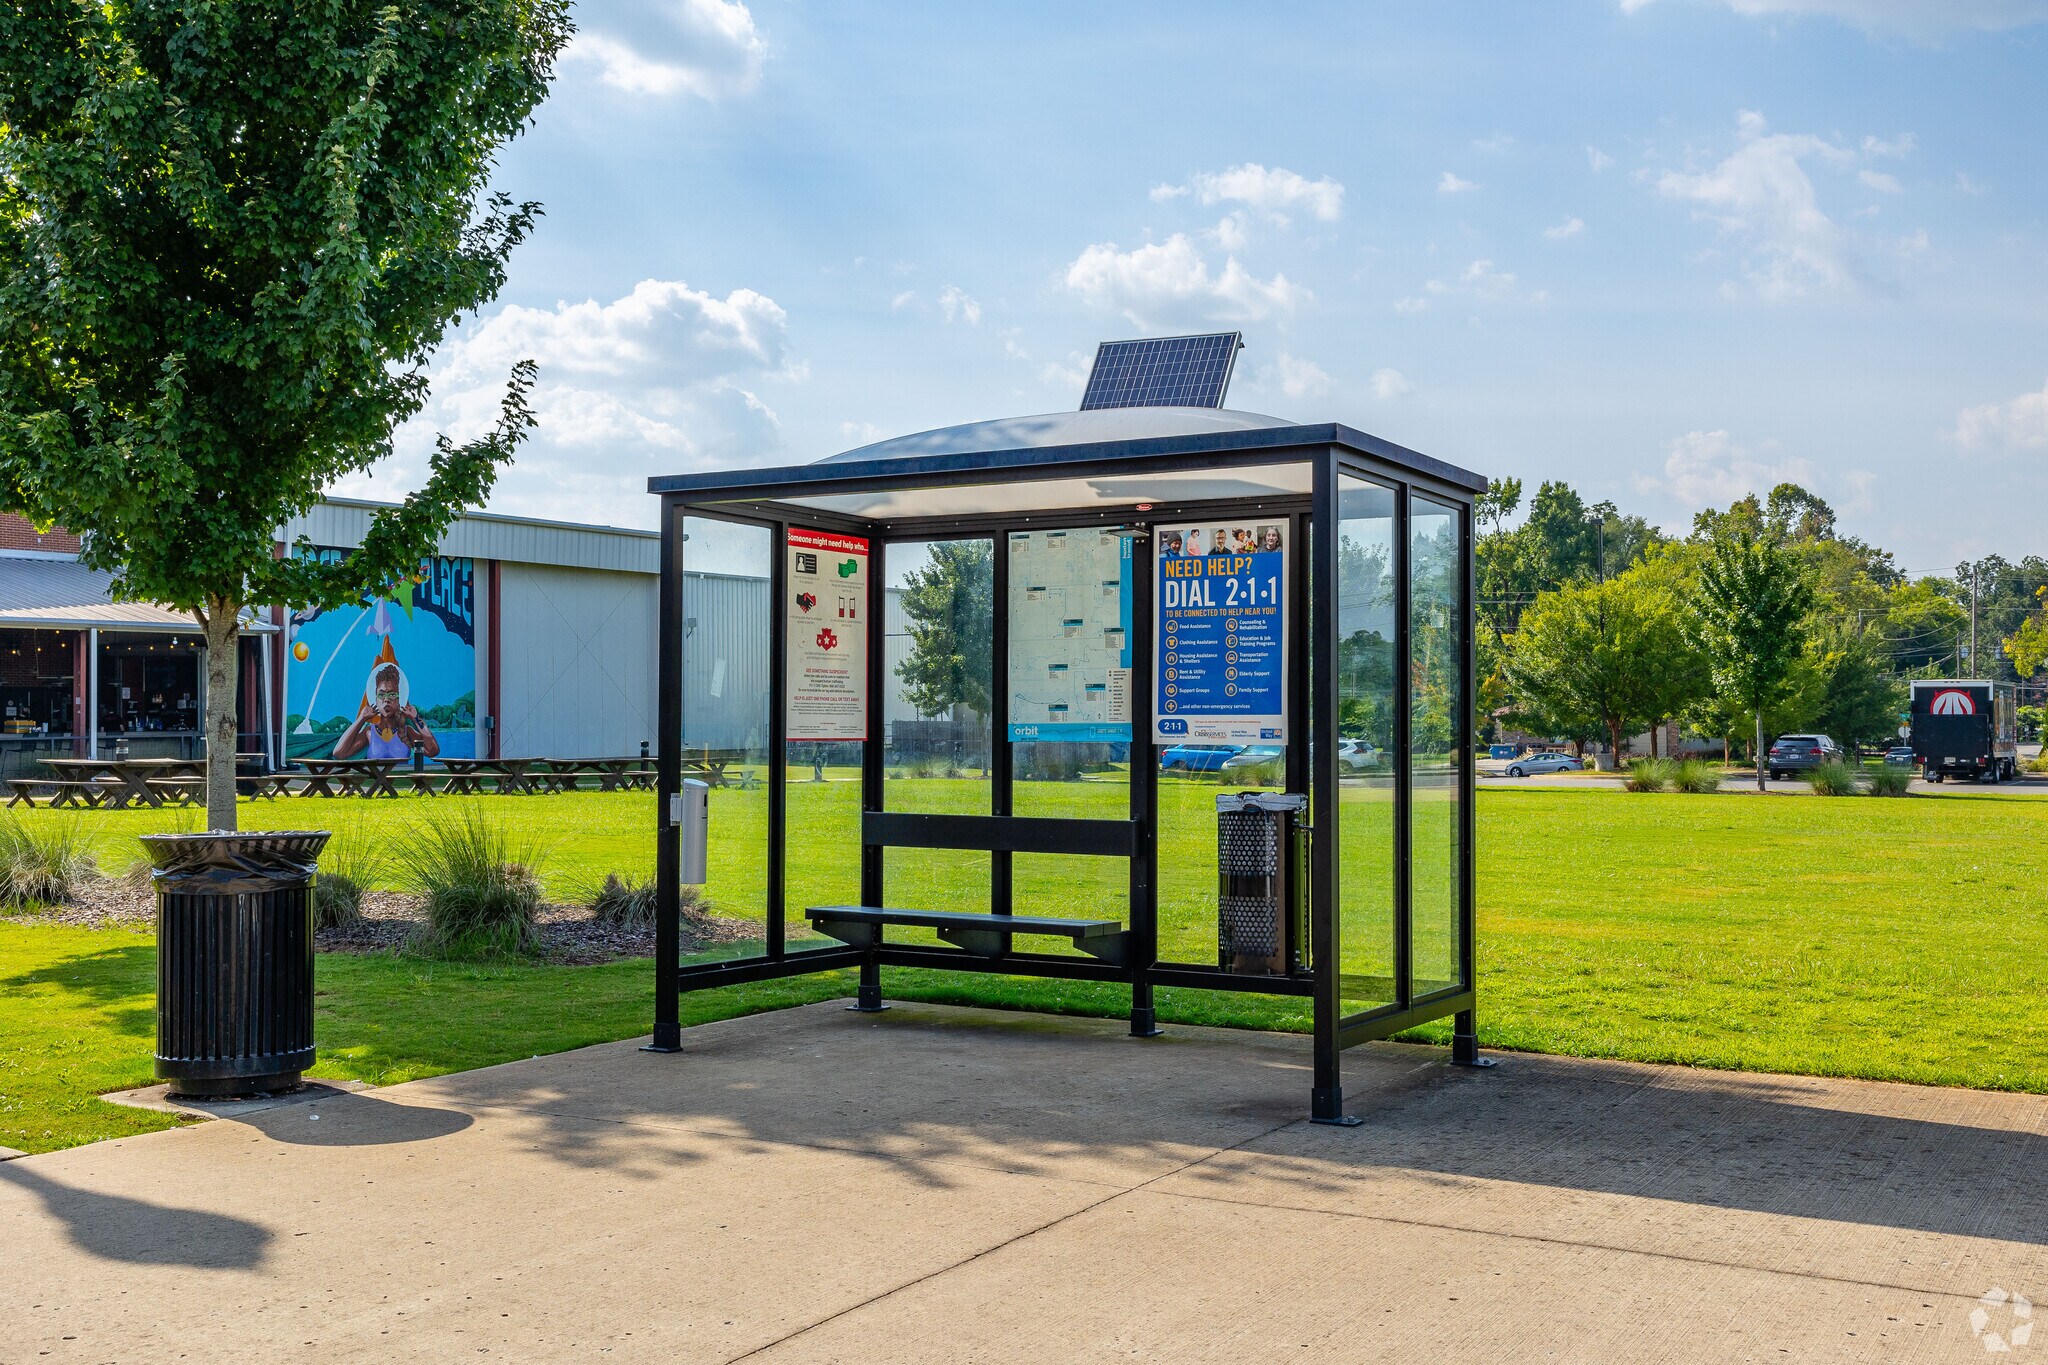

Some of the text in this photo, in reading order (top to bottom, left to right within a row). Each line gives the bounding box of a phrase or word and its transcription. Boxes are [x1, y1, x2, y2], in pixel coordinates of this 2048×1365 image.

[788, 533, 812, 543] Someone
[813, 537, 827, 547] might
[843, 540, 853, 550] help
[1166, 557, 1252, 577] NEED HELP?
[421, 557, 472, 626] PLACE
[1166, 580, 1215, 607] DIAL
[1015, 726, 1038, 735] orbit
